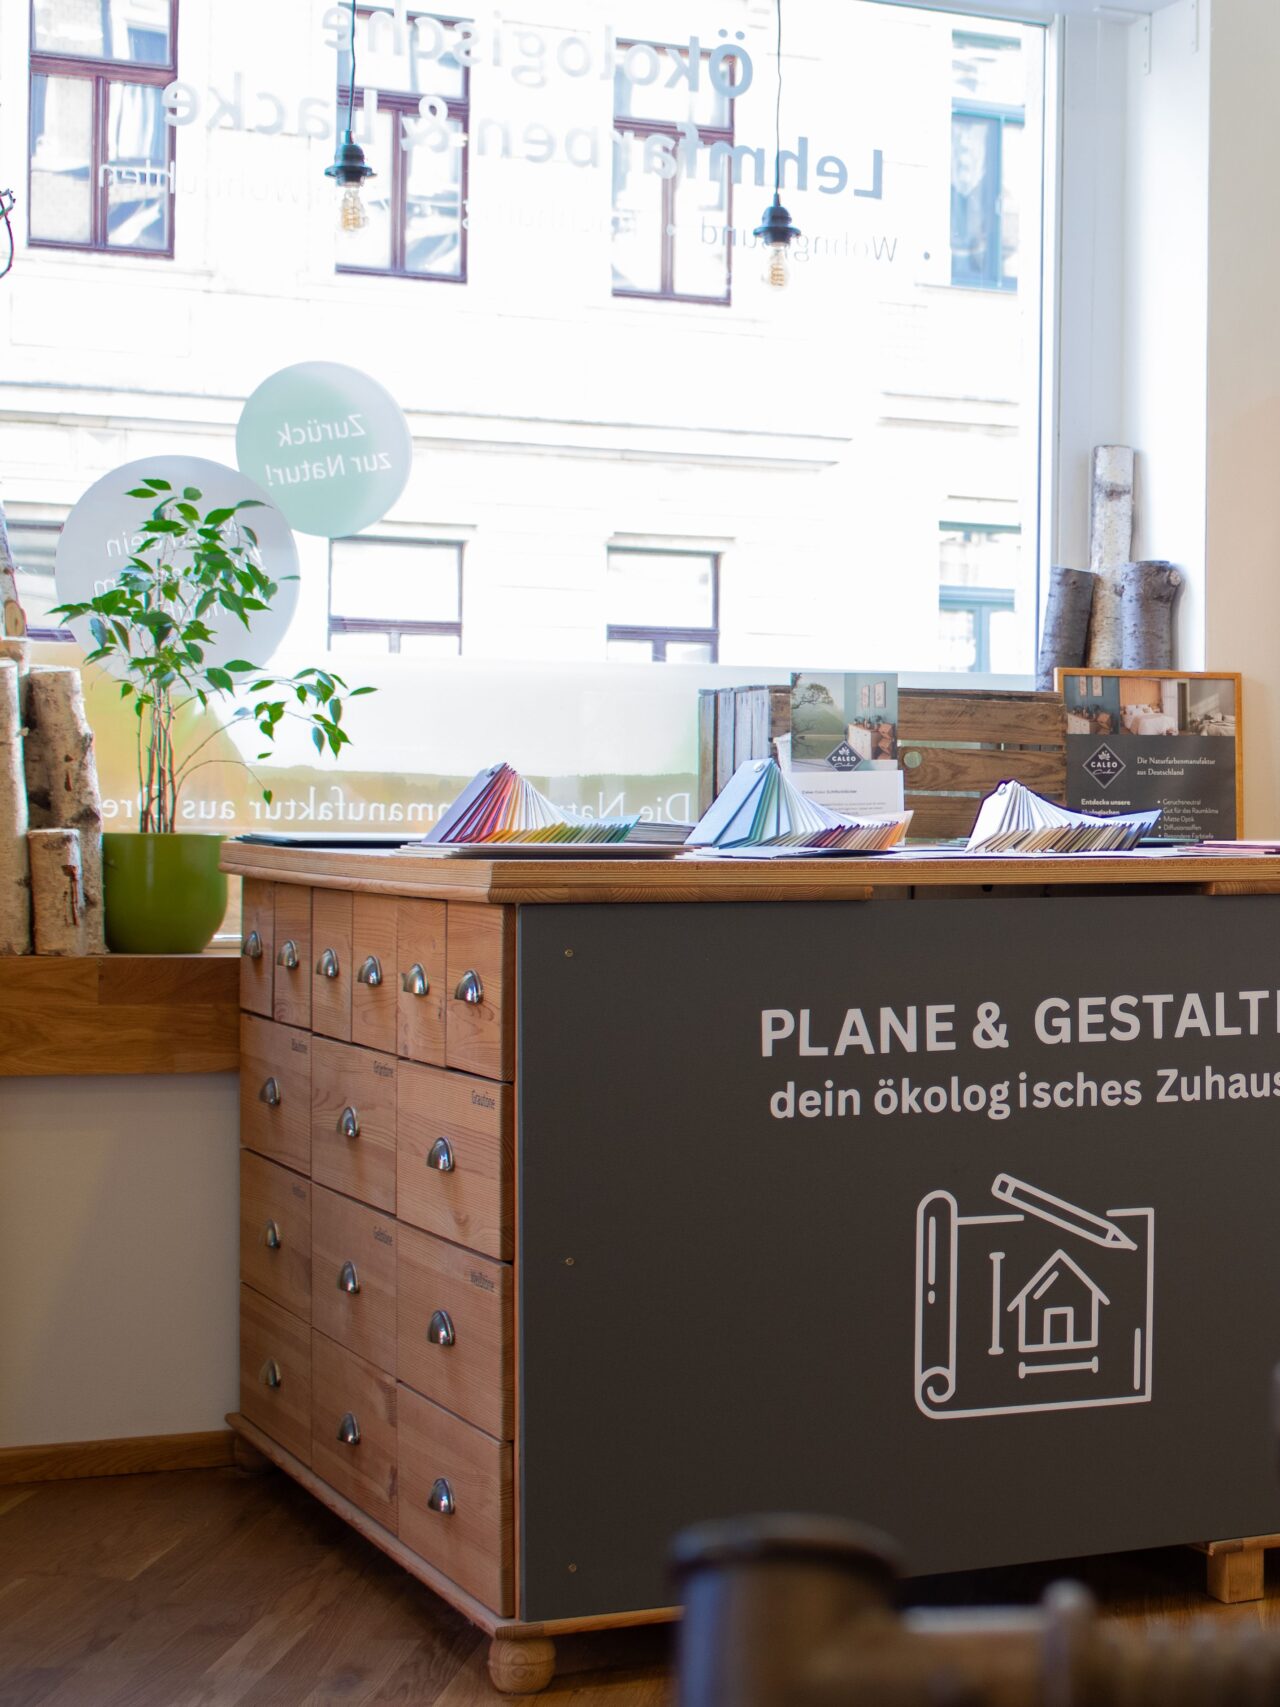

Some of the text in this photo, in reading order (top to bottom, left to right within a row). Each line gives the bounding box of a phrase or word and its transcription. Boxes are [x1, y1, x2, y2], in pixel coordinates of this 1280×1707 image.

[1149, 757, 1216, 765] Naturfarbenmanufaktur
[1147, 768, 1184, 776] Deutschland
[1081, 798, 1110, 806] Entdecke
[761, 1004, 956, 1057] PLANE
[972, 1001, 1009, 1050] &
[769, 1081, 860, 1119] dein
[873, 1072, 1142, 1120] ökologisches
